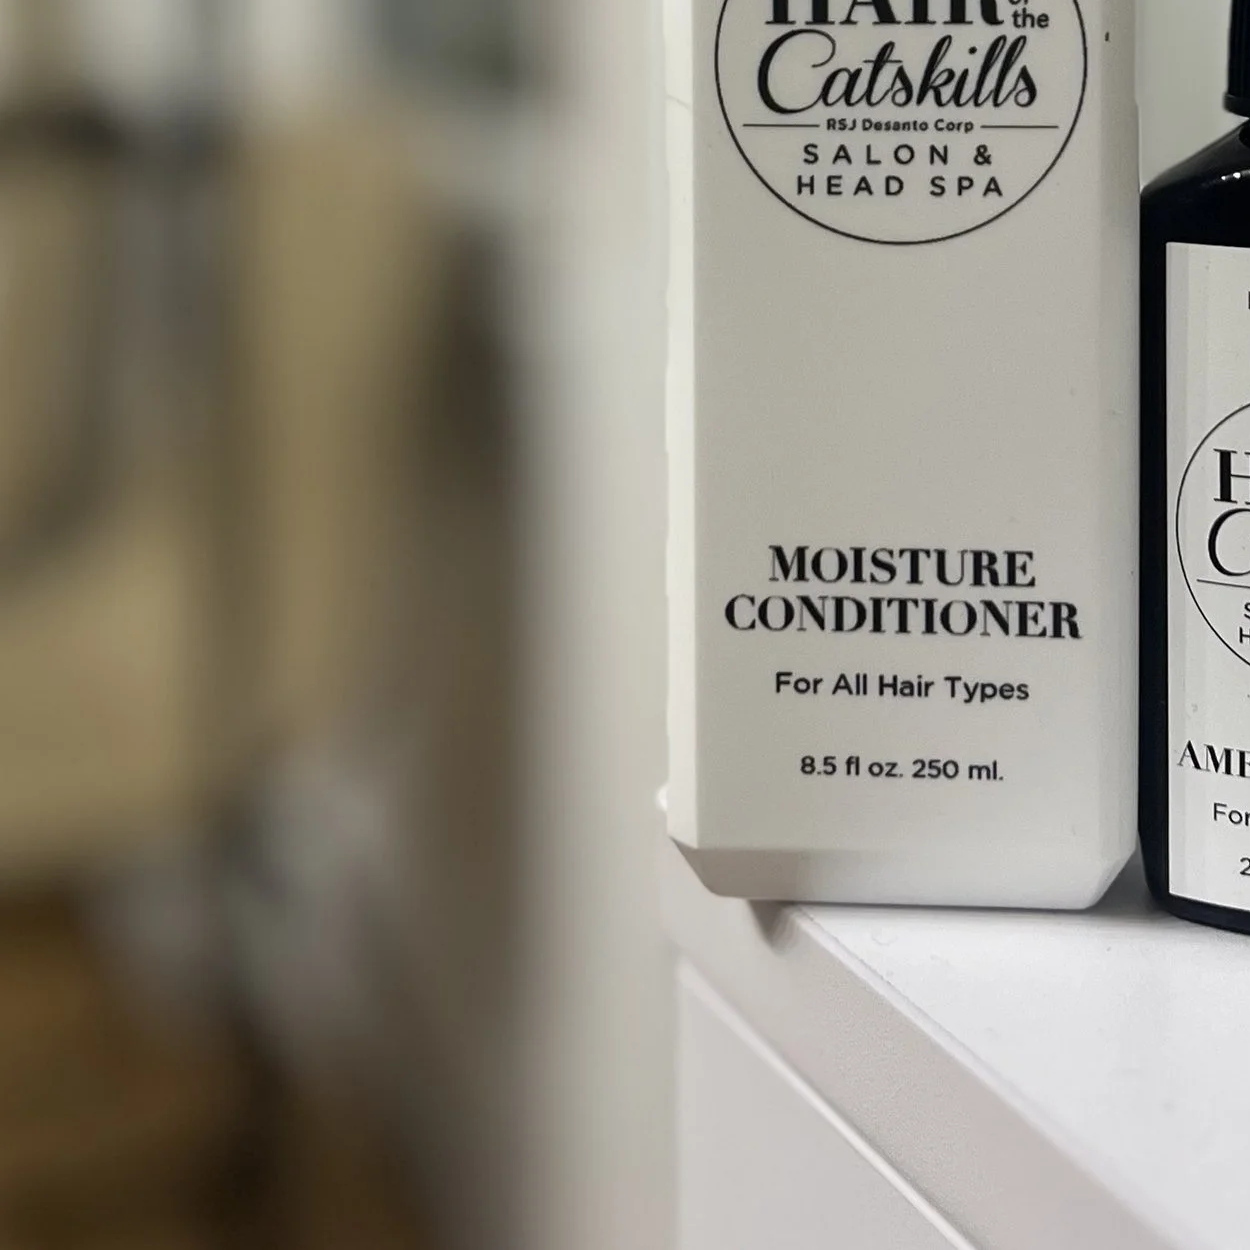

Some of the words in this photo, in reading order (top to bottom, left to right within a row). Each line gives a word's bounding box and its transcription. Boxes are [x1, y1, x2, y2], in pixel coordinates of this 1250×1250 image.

[1012, 7, 1049, 29] the
[757, 29, 1037, 115] Catskills
[826, 118, 857, 131] RSJ
[862, 118, 929, 132] Desanto
[934, 118, 974, 134] Corp
[803, 143, 948, 166] SALON
[973, 144, 992, 166] &
[797, 175, 904, 196] HEAD
[930, 176, 1003, 197] SPA
[769, 545, 1035, 588] MOISTURE
[725, 594, 1082, 639] CONDITIONER
[776, 671, 823, 695] For
[832, 673, 867, 696] All
[879, 674, 934, 698] Hair
[944, 676, 1029, 704] Types
[800, 755, 837, 776] 8.5
[845, 756, 860, 776] fl
[868, 762, 903, 778] oz.
[912, 759, 959, 780] 250
[968, 760, 1003, 780] ml.
